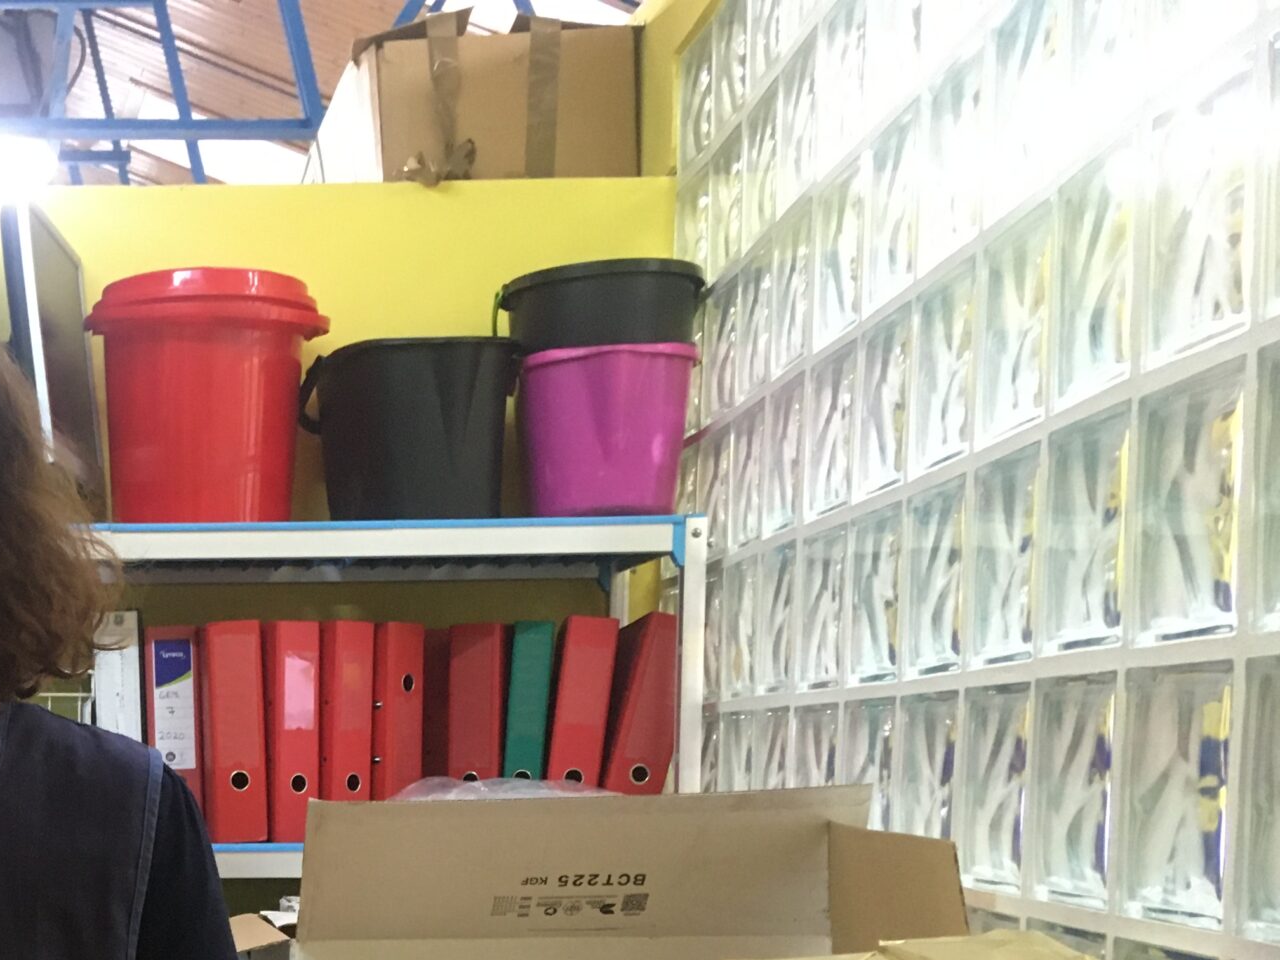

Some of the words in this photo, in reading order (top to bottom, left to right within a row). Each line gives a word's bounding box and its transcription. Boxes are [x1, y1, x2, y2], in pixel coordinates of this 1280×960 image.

[158, 731, 185, 741] 2020
[520, 875, 549, 886] KGF
[557, 873, 647, 888] BCT225
